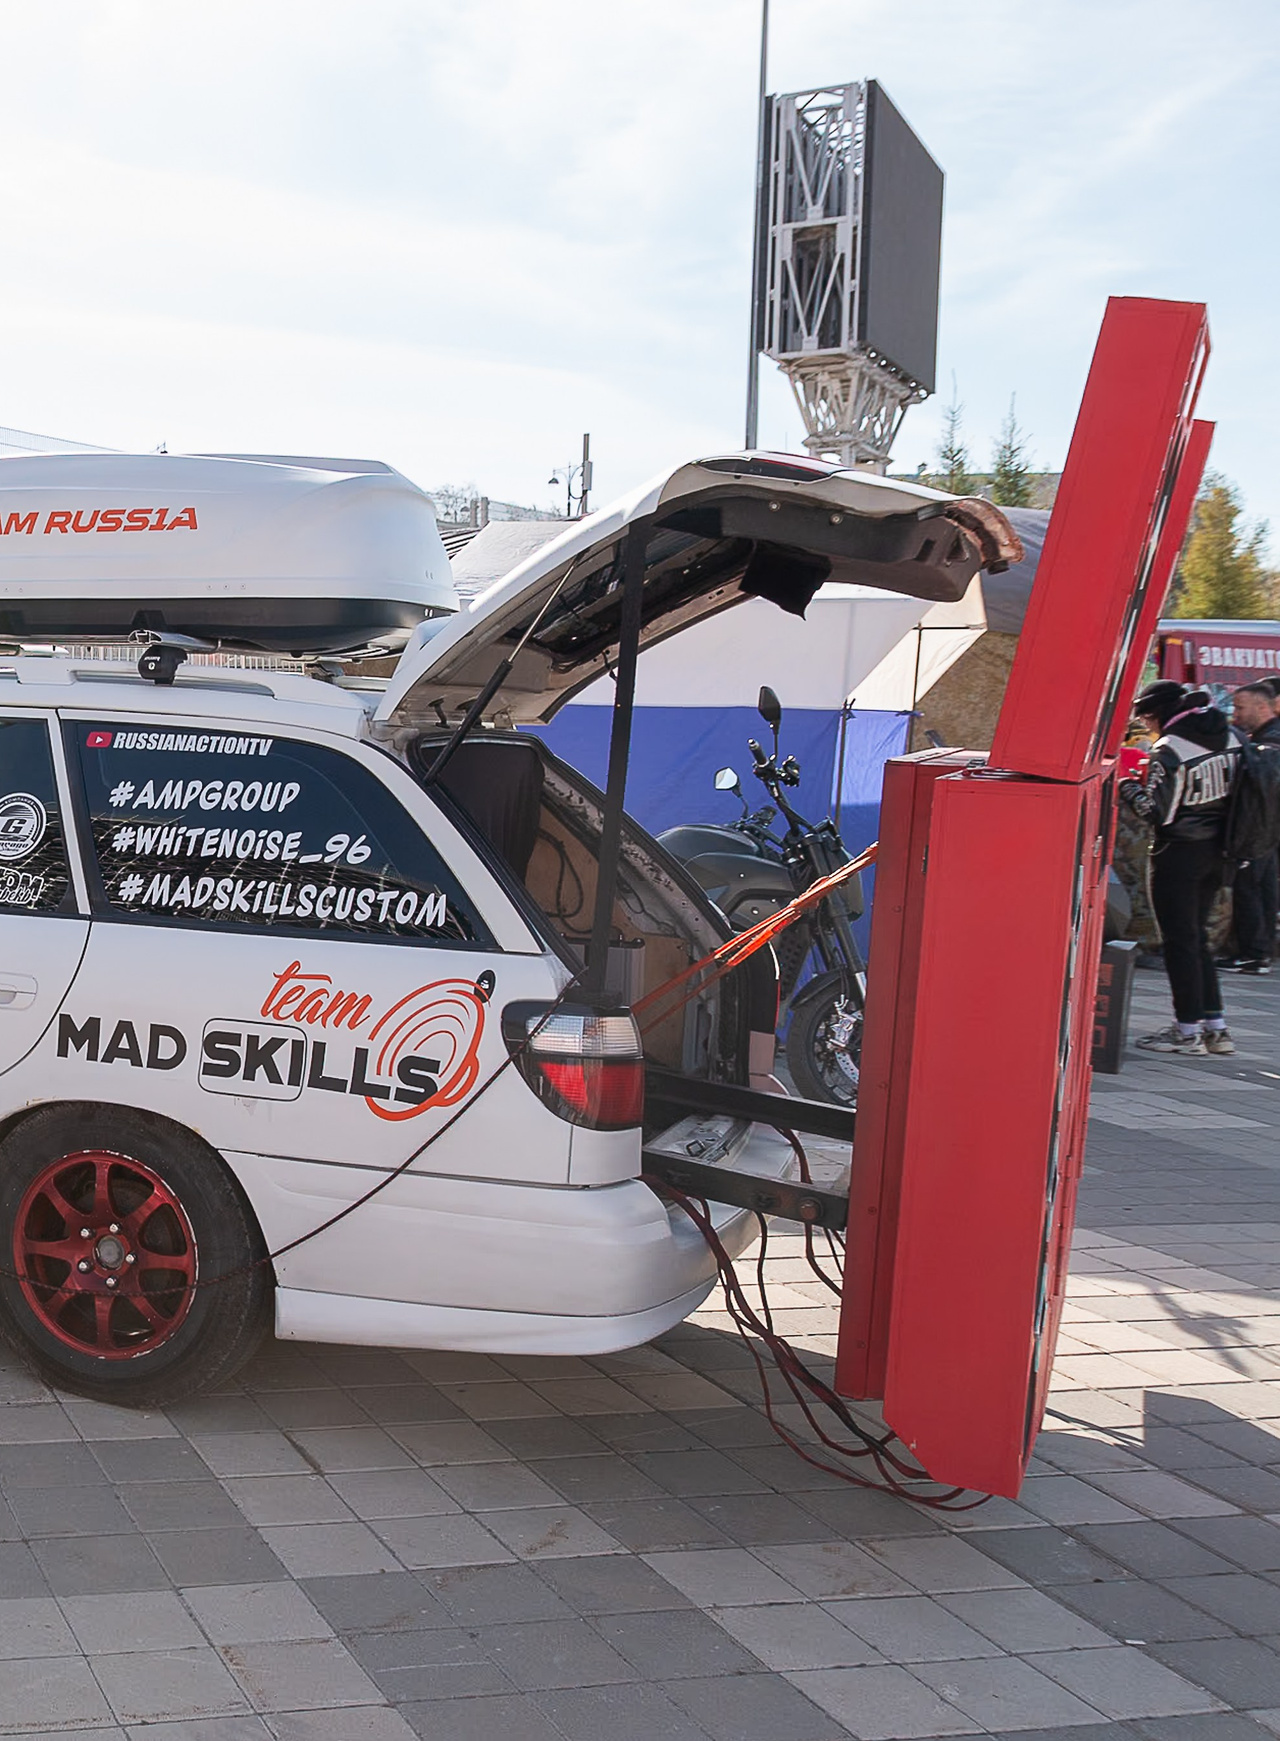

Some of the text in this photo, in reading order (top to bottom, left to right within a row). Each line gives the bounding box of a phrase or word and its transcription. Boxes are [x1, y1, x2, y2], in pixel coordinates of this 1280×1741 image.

[1199, 645, 1280, 671] ЭВАКУАТ
[113, 732, 273, 757] RUSSIANACTIONTV
[108, 779, 300, 814] #AMPGROUP
[260, 959, 372, 1031] team
[56, 1013, 441, 1106] MAD SKILLS
